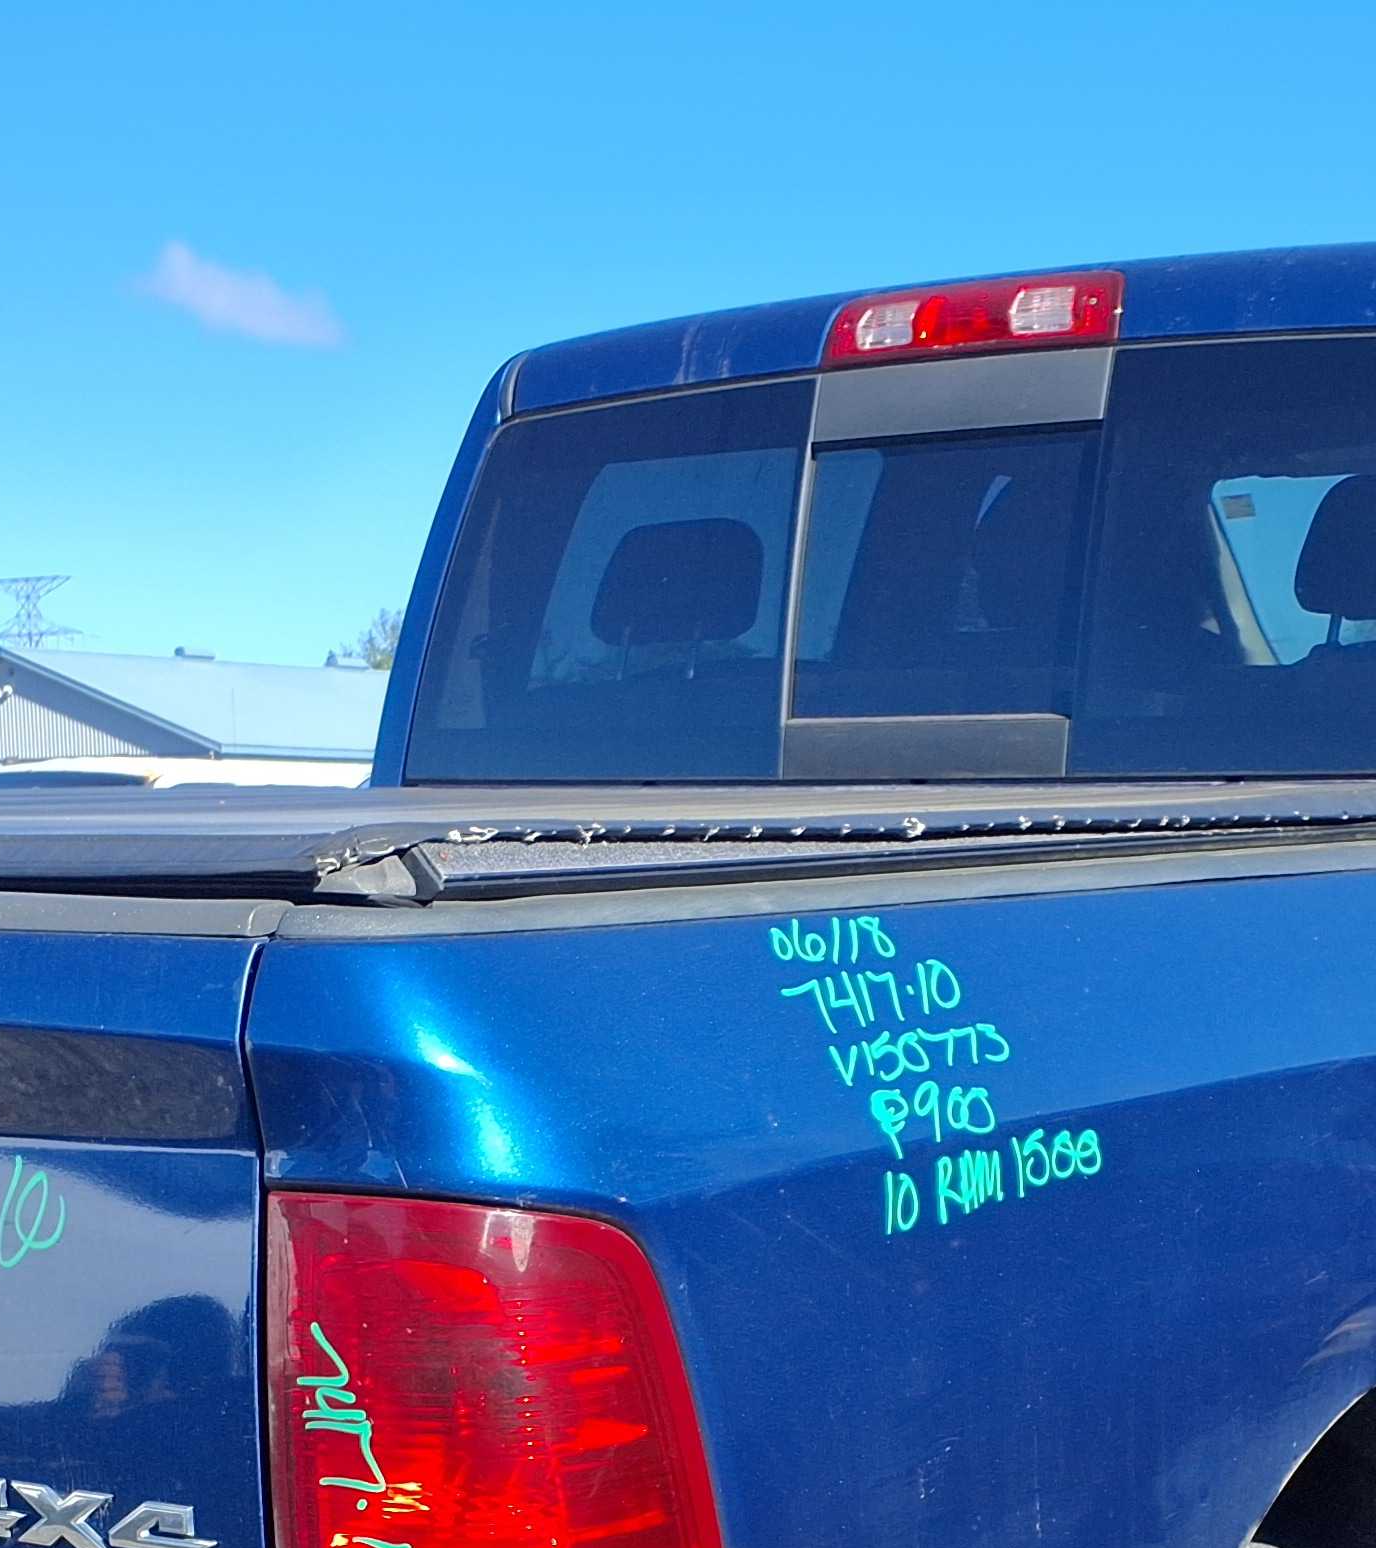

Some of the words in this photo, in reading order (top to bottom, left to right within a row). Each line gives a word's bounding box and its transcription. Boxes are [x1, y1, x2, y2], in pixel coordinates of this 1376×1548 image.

[781, 958, 962, 1034] 7417.10
[883, 1171, 921, 1236] 10
[936, 1149, 1005, 1225] RAM
